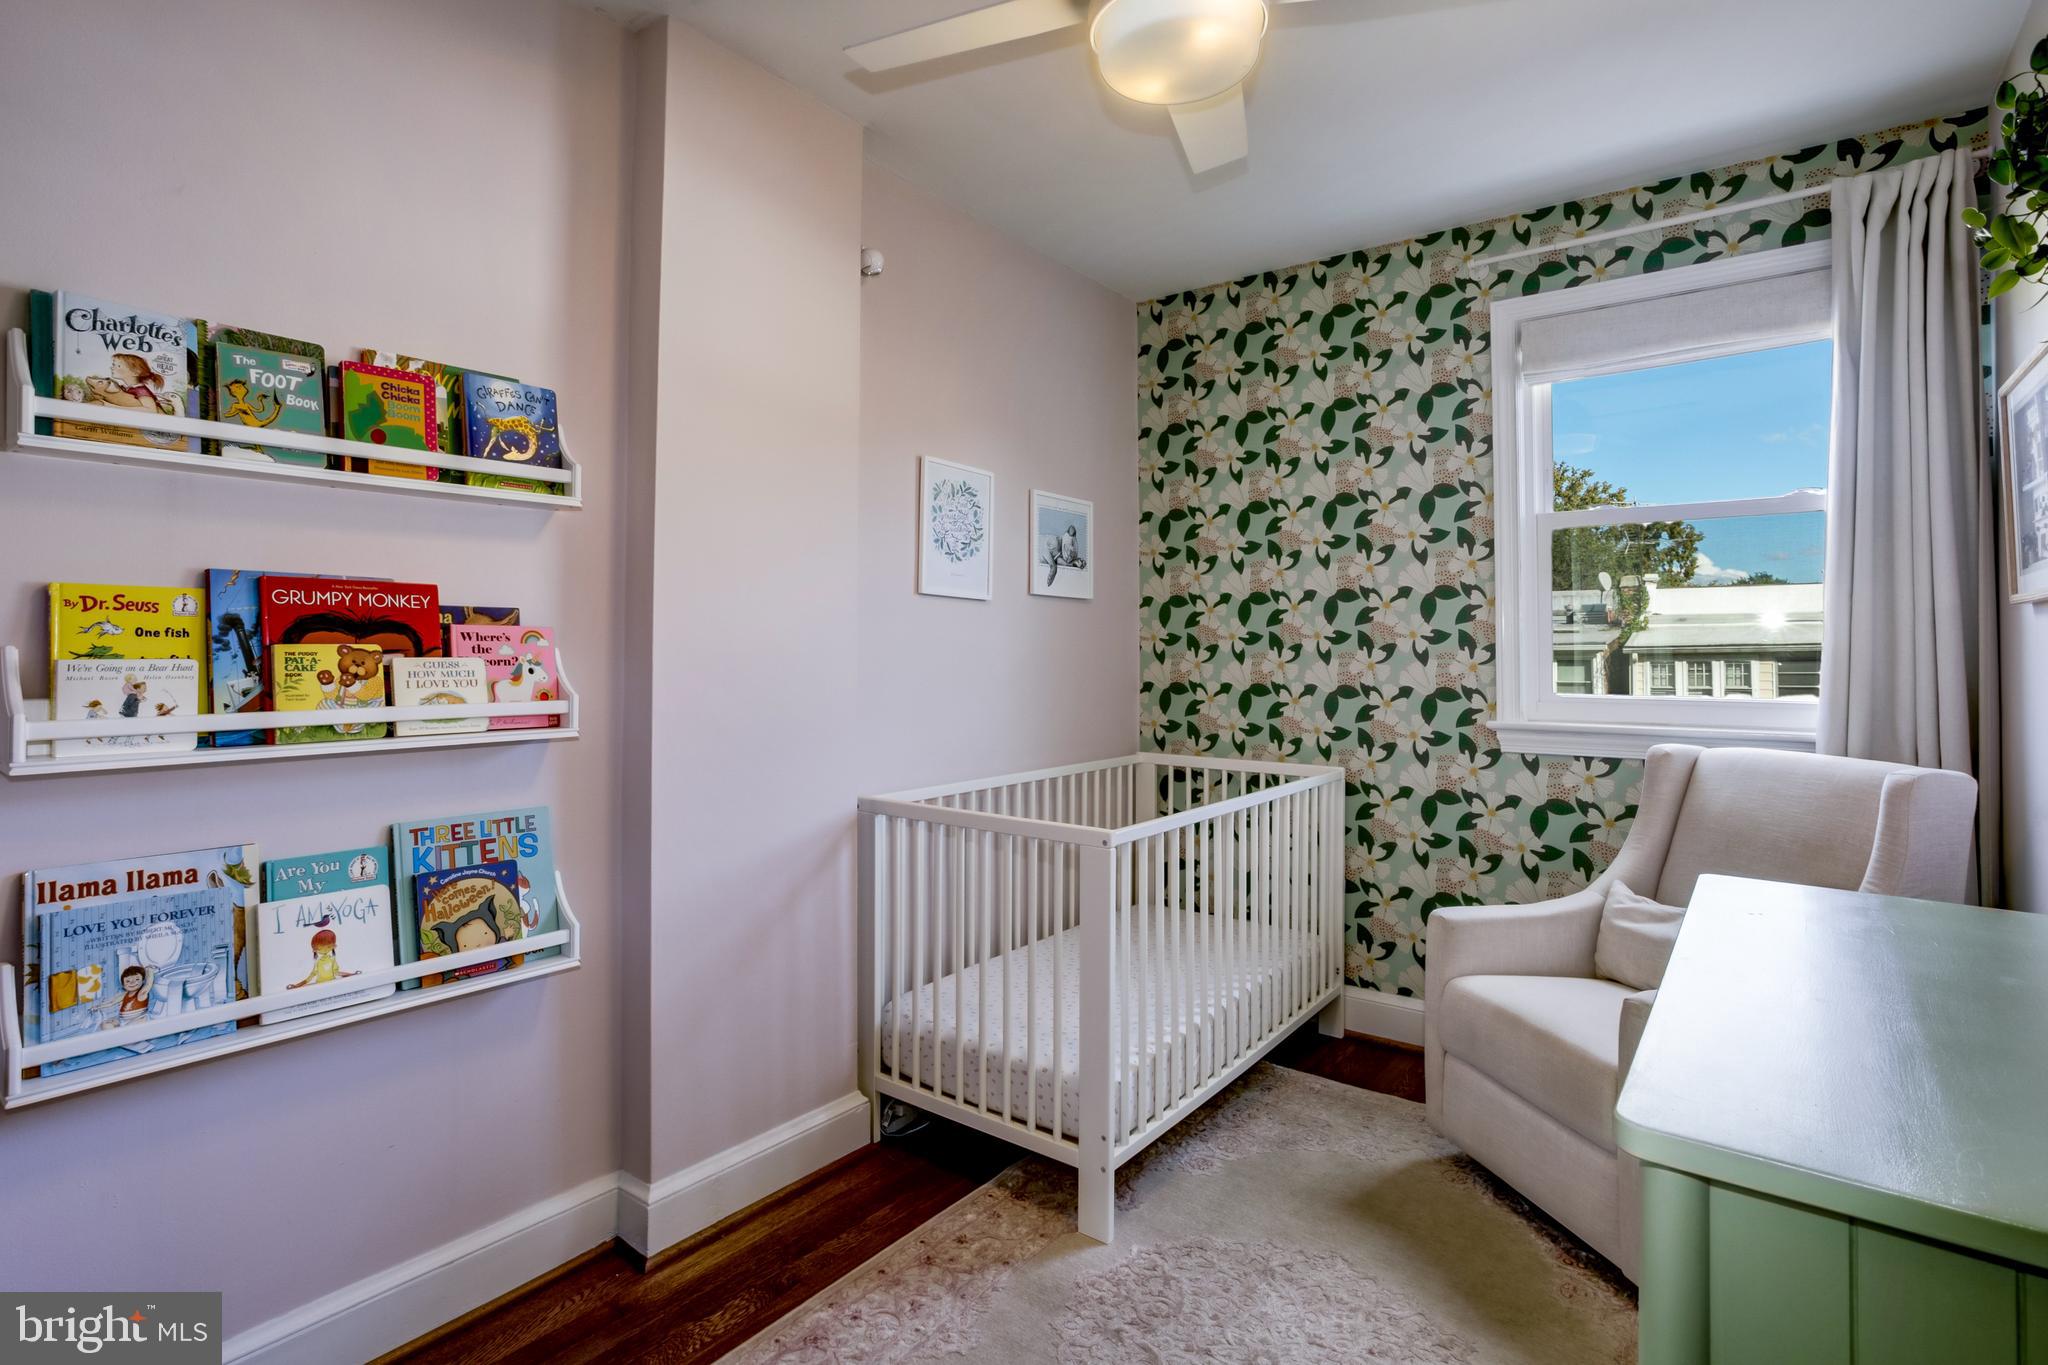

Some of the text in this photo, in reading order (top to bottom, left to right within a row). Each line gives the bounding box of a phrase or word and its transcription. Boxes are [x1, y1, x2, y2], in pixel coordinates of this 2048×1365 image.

[65, 308, 182, 347] Charlotte's
[98, 332, 153, 353] Web
[233, 355, 256, 366] The
[249, 369, 303, 391] FOOT
[380, 382, 420, 396] Chicka
[381, 391, 420, 405] Chicka
[496, 401, 536, 416] DANCE
[63, 594, 159, 613] By Dr. Seuss
[271, 589, 431, 608] GRUMPY MONKEY
[135, 627, 190, 638] One fish
[460, 632, 511, 642] Where's
[472, 644, 492, 654] the
[67, 664, 92, 672] We're
[96, 664, 122, 673] Going
[148, 664, 168, 672] Bear
[171, 664, 193, 672] Hunt
[285, 664, 317, 672] CAKE
[423, 661, 460, 669] GUESS
[408, 670, 475, 679] HOW MUCH
[406, 680, 478, 689] I LOVE YOU
[409, 815, 537, 846] THREE LITTLE
[412, 832, 538, 874] KITTENS
[276, 867, 305, 881] Are
[311, 861, 340, 875] You
[37, 868, 199, 904] llama llama
[298, 878, 326, 894] My
[442, 885, 476, 904] comes
[423, 878, 496, 922] Halloween!
[63, 905, 216, 938] LOVE YOU FOREVER
[272, 904, 284, 934] I
[296, 902, 324, 928] AM
